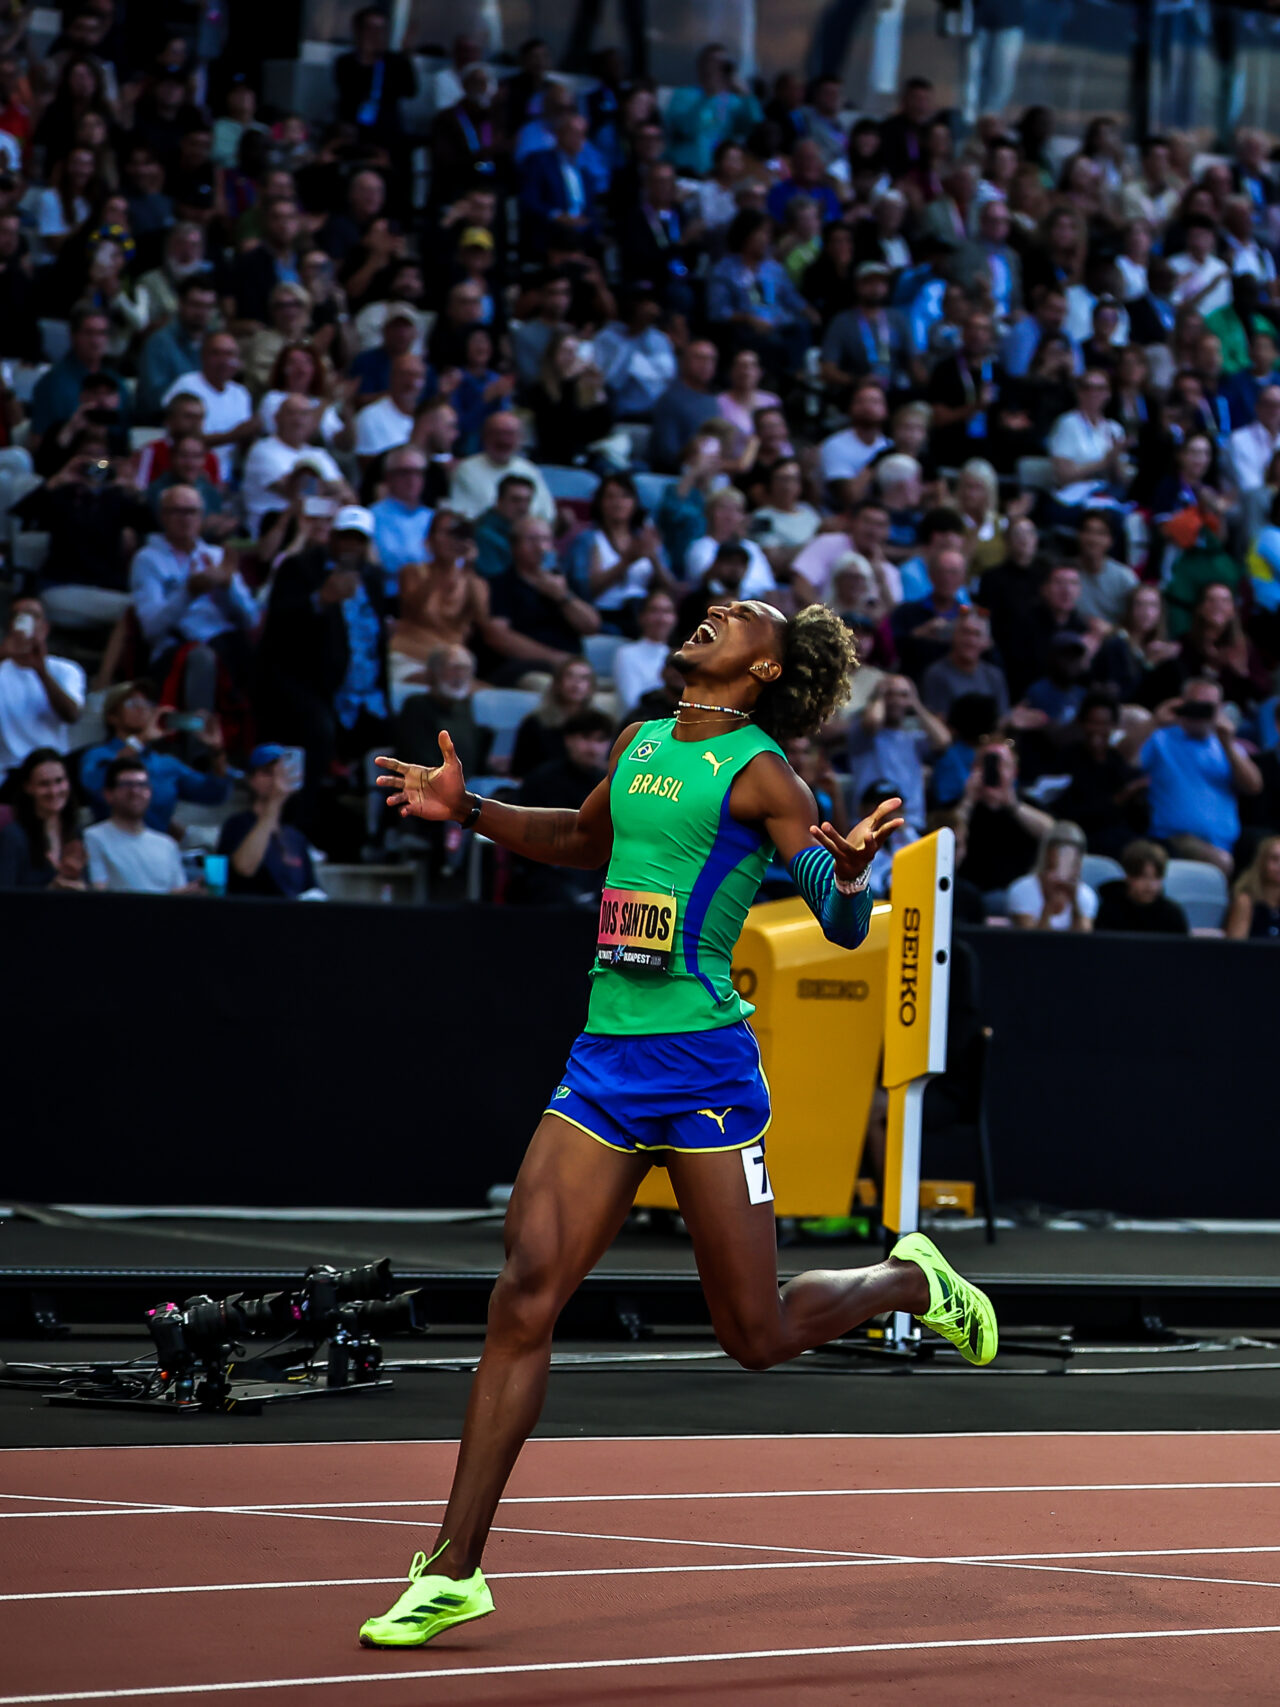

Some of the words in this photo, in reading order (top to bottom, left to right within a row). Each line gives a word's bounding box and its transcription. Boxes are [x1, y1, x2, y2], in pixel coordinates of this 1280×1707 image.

[628, 774, 683, 802] BRASIL
[600, 900, 618, 936] DOS
[620, 902, 672, 941] SANTOS
[899, 907, 921, 1027] SEIKO
